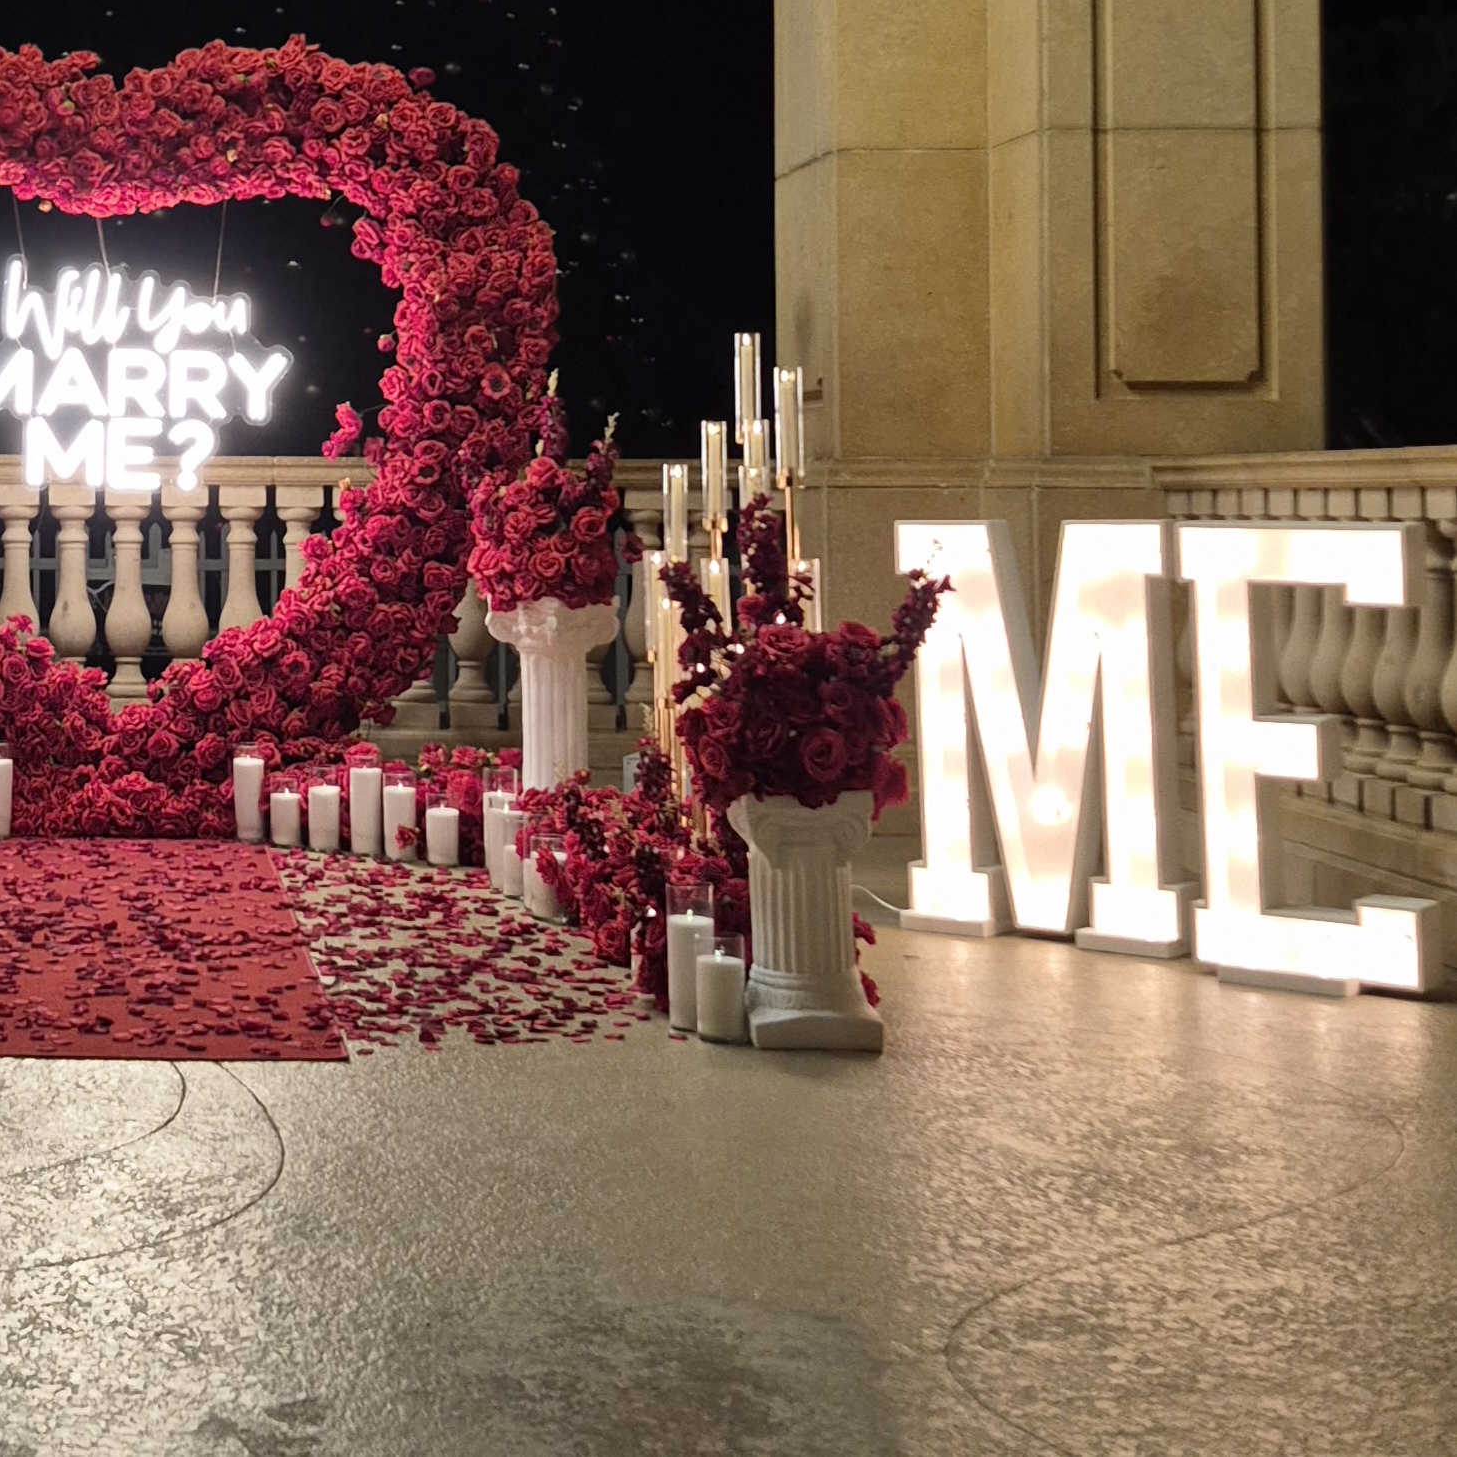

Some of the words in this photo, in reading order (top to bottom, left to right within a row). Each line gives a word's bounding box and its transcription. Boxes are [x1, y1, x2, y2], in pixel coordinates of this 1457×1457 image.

[7, 259, 130, 360] Will
[138, 274, 247, 354] You
[25, 417, 216, 491] ME?
[894, 520, 1429, 990] ME
